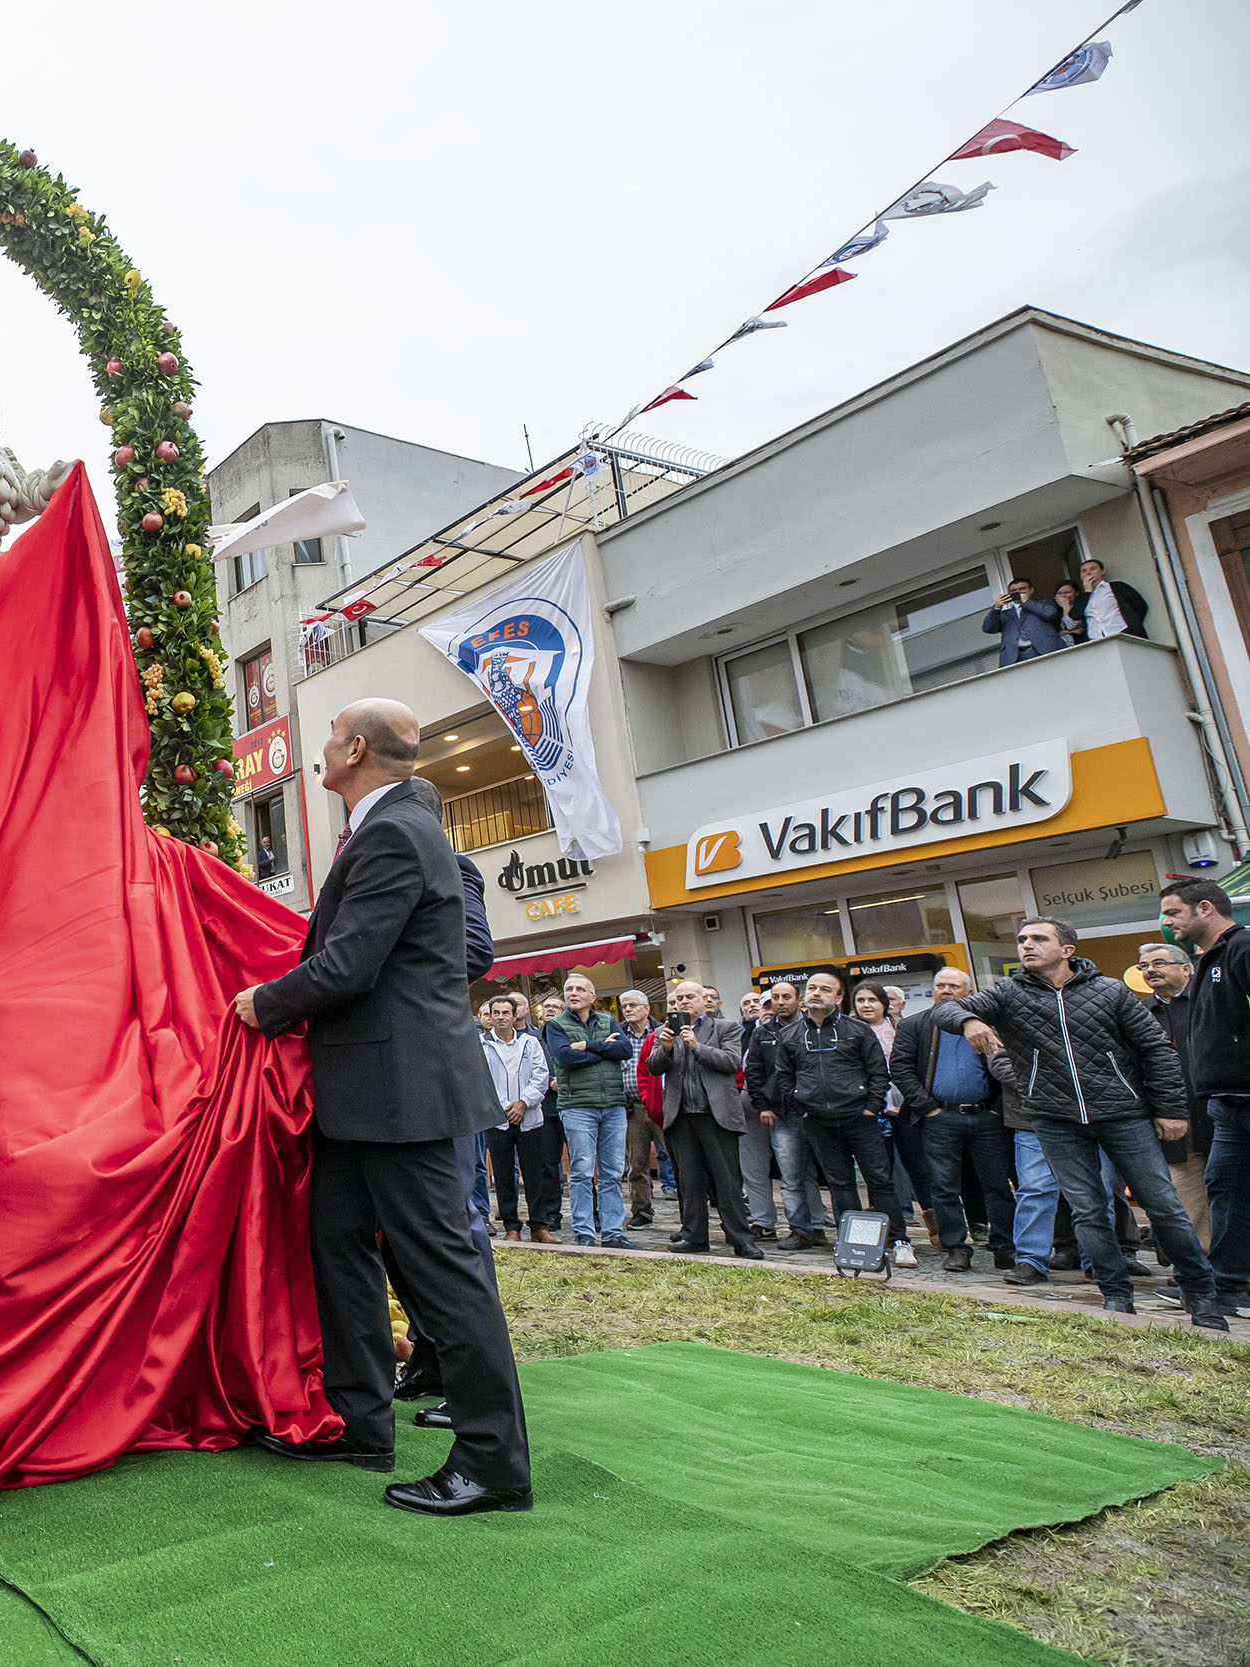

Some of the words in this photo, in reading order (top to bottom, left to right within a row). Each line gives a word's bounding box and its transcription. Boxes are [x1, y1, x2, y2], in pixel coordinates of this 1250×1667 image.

[470, 621, 530, 648] EFES
[759, 762, 1051, 861] VakıfBank
[525, 894, 578, 919] CAFE
[1043, 887, 1094, 907] Selçuk
[1099, 880, 1154, 900] Şubesi
